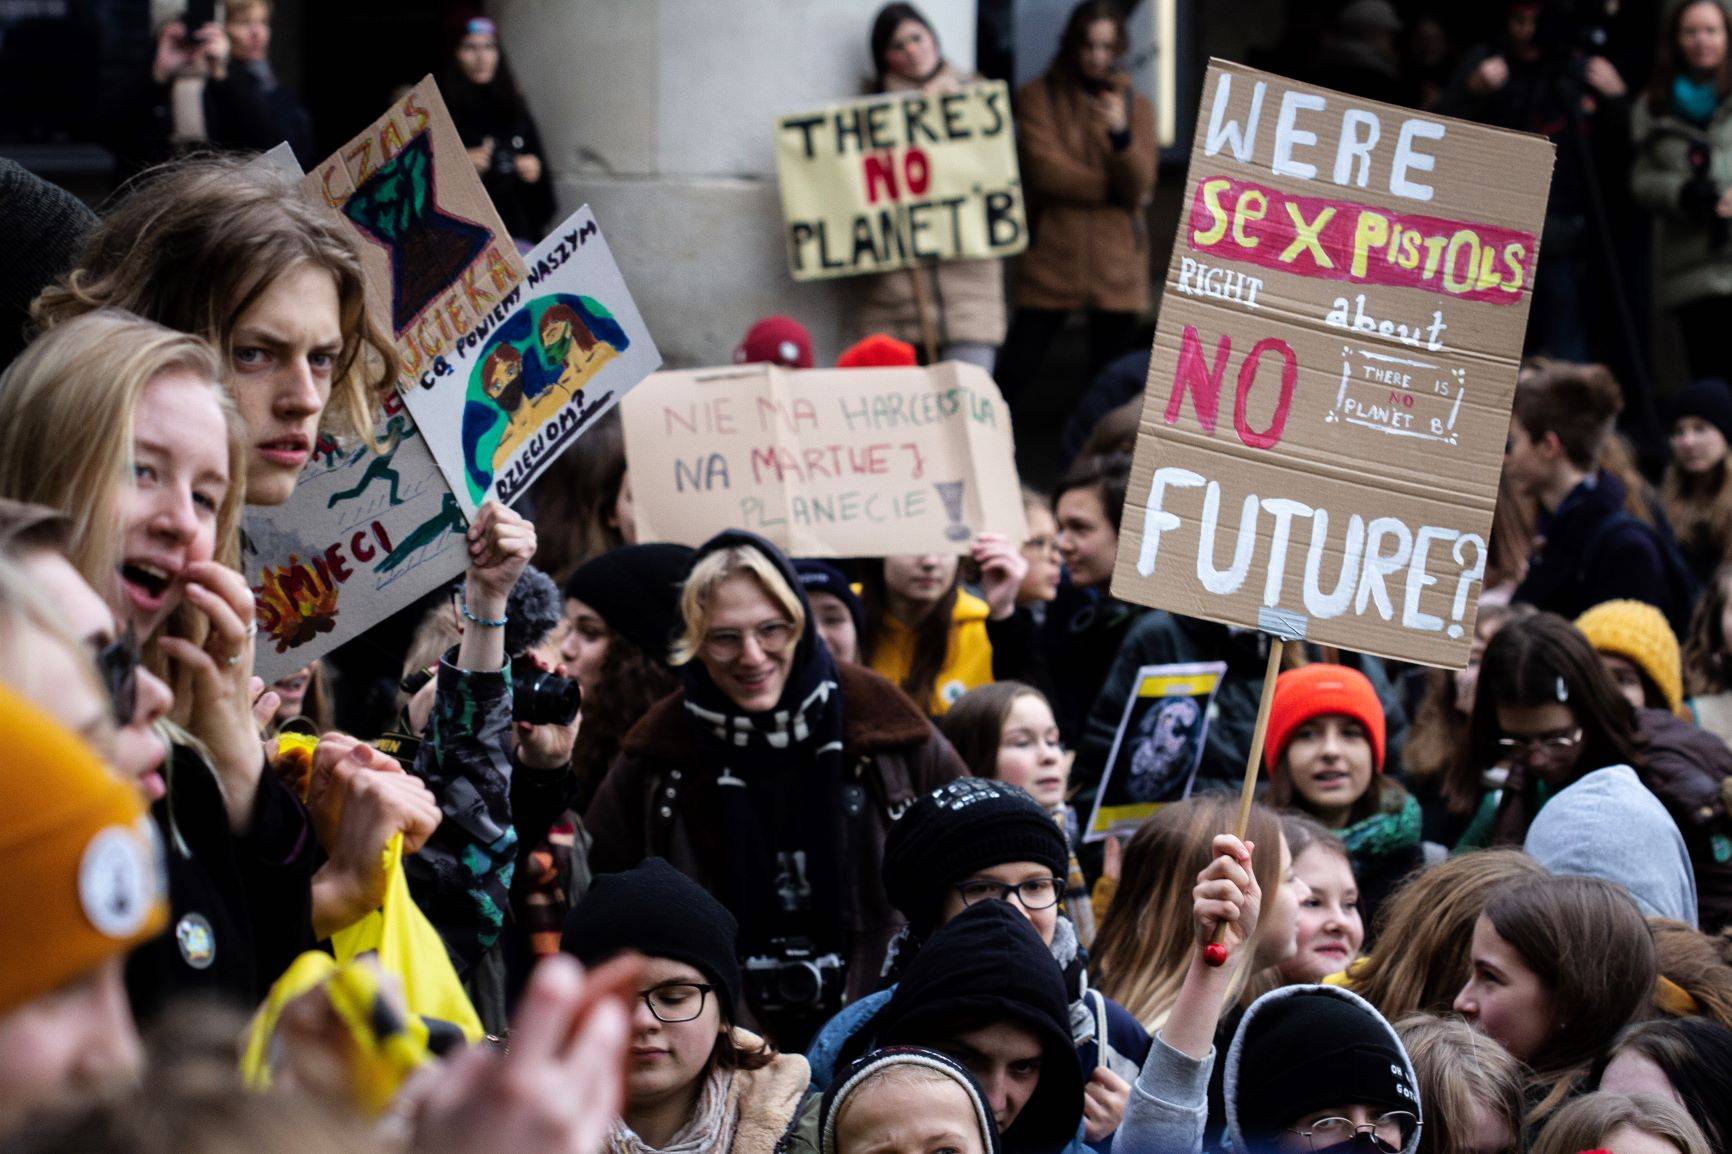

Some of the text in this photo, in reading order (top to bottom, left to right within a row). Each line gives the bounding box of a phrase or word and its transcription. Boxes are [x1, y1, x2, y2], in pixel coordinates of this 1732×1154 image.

[321, 93, 430, 207] CZAS
[781, 90, 1003, 159] THERE'S
[1204, 72, 1446, 201] WERE
[863, 146, 931, 203] NO
[527, 219, 597, 289] NASZYM
[792, 198, 964, 270] PLANET
[1178, 256, 1447, 351] RIGHT about
[1163, 324, 1298, 449] NO
[1362, 365, 1449, 396] THERE IS
[1388, 390, 1414, 408] NO
[495, 388, 585, 500] DZIECIOM?
[662, 397, 739, 436] NIE
[754, 396, 820, 434] MA
[1430, 417, 1444, 435] B
[674, 452, 730, 493] NA
[1136, 467, 1488, 640] FUTURE?
